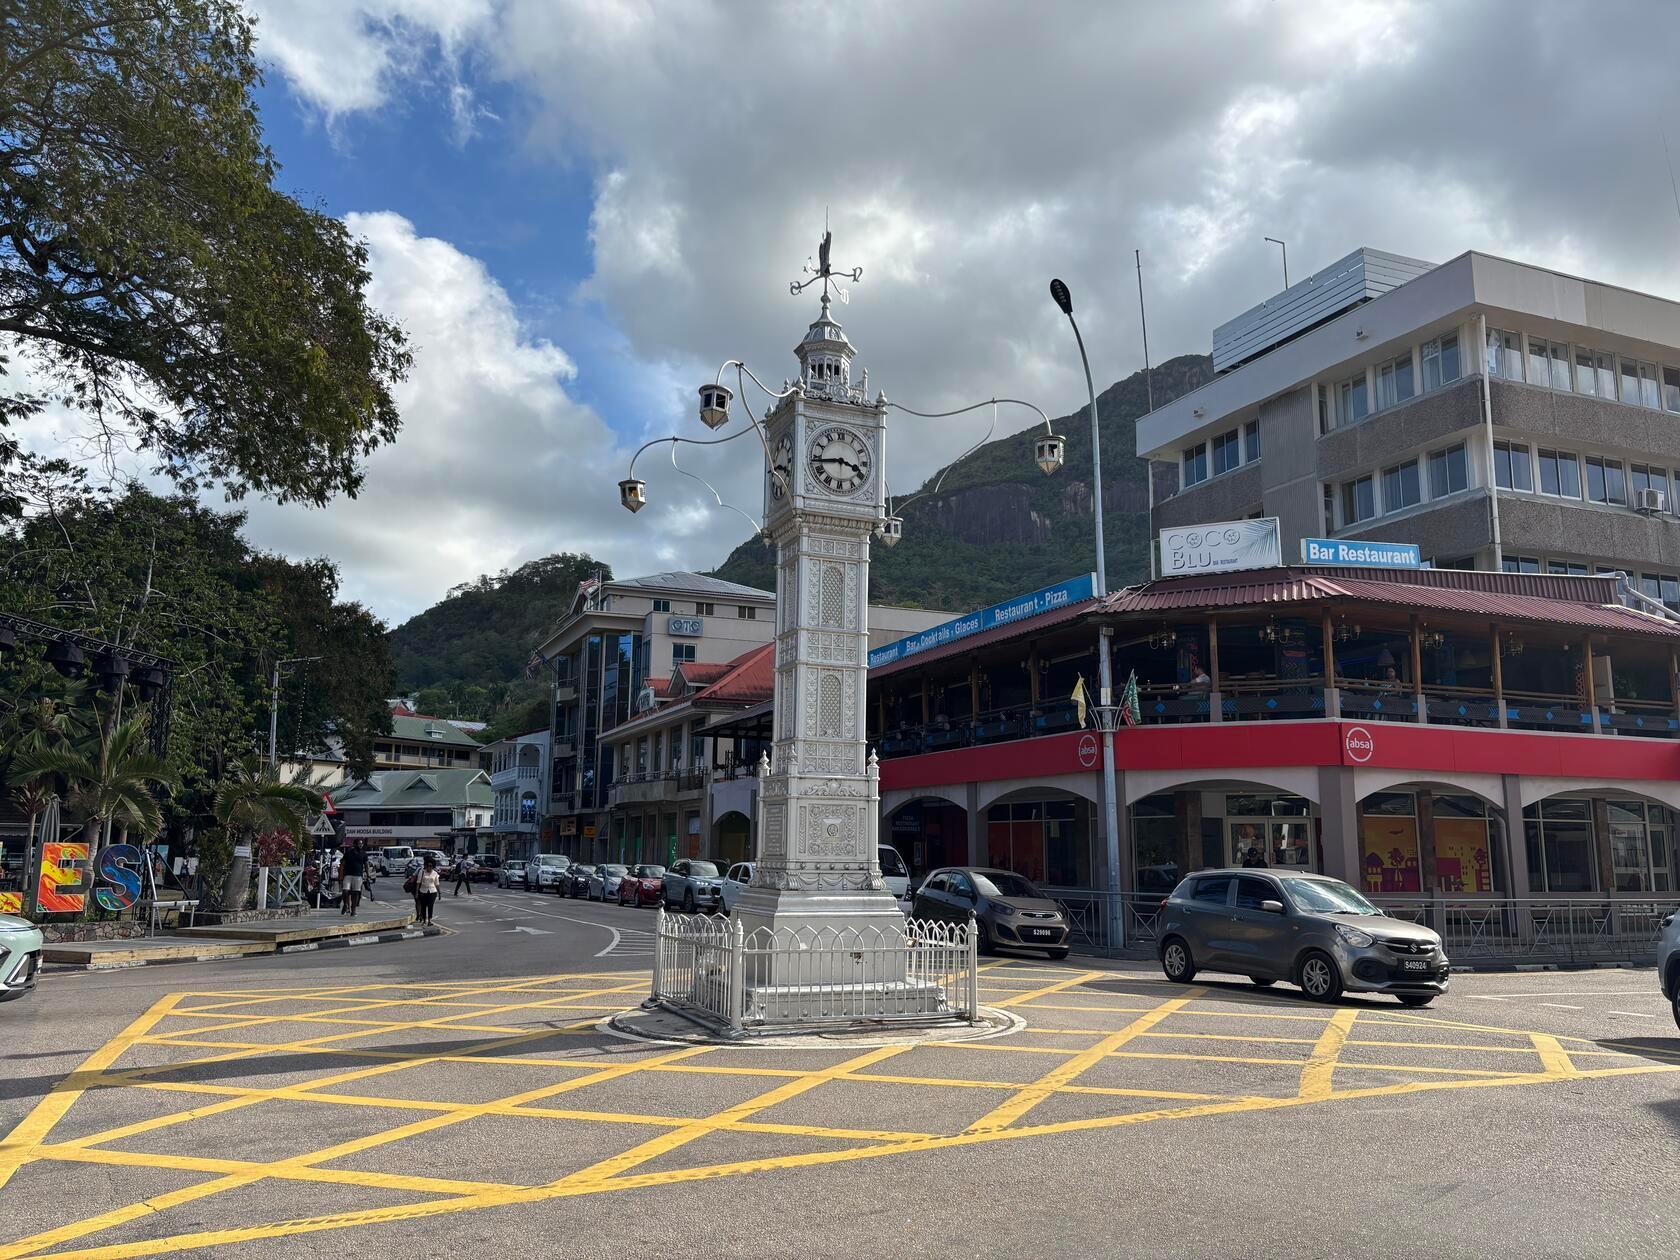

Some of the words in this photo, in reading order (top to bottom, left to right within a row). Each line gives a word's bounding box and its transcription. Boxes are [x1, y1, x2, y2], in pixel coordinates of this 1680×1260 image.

[1168, 529, 1241, 550] COCO
[1172, 551, 1211, 570] BLU
[1309, 543, 1335, 560] Bar
[1338, 544, 1416, 564] Restaurant
[994, 596, 1039, 622] Restaurant
[1045, 590, 1068, 606] Pizza
[906, 641, 917, 652] Bar
[920, 627, 950, 646] Cocktails
[955, 618, 979, 634] Glaces
[870, 646, 898, 663] Restaurant
[1081, 744, 1095, 755] absa
[1350, 737, 1370, 749] absa
